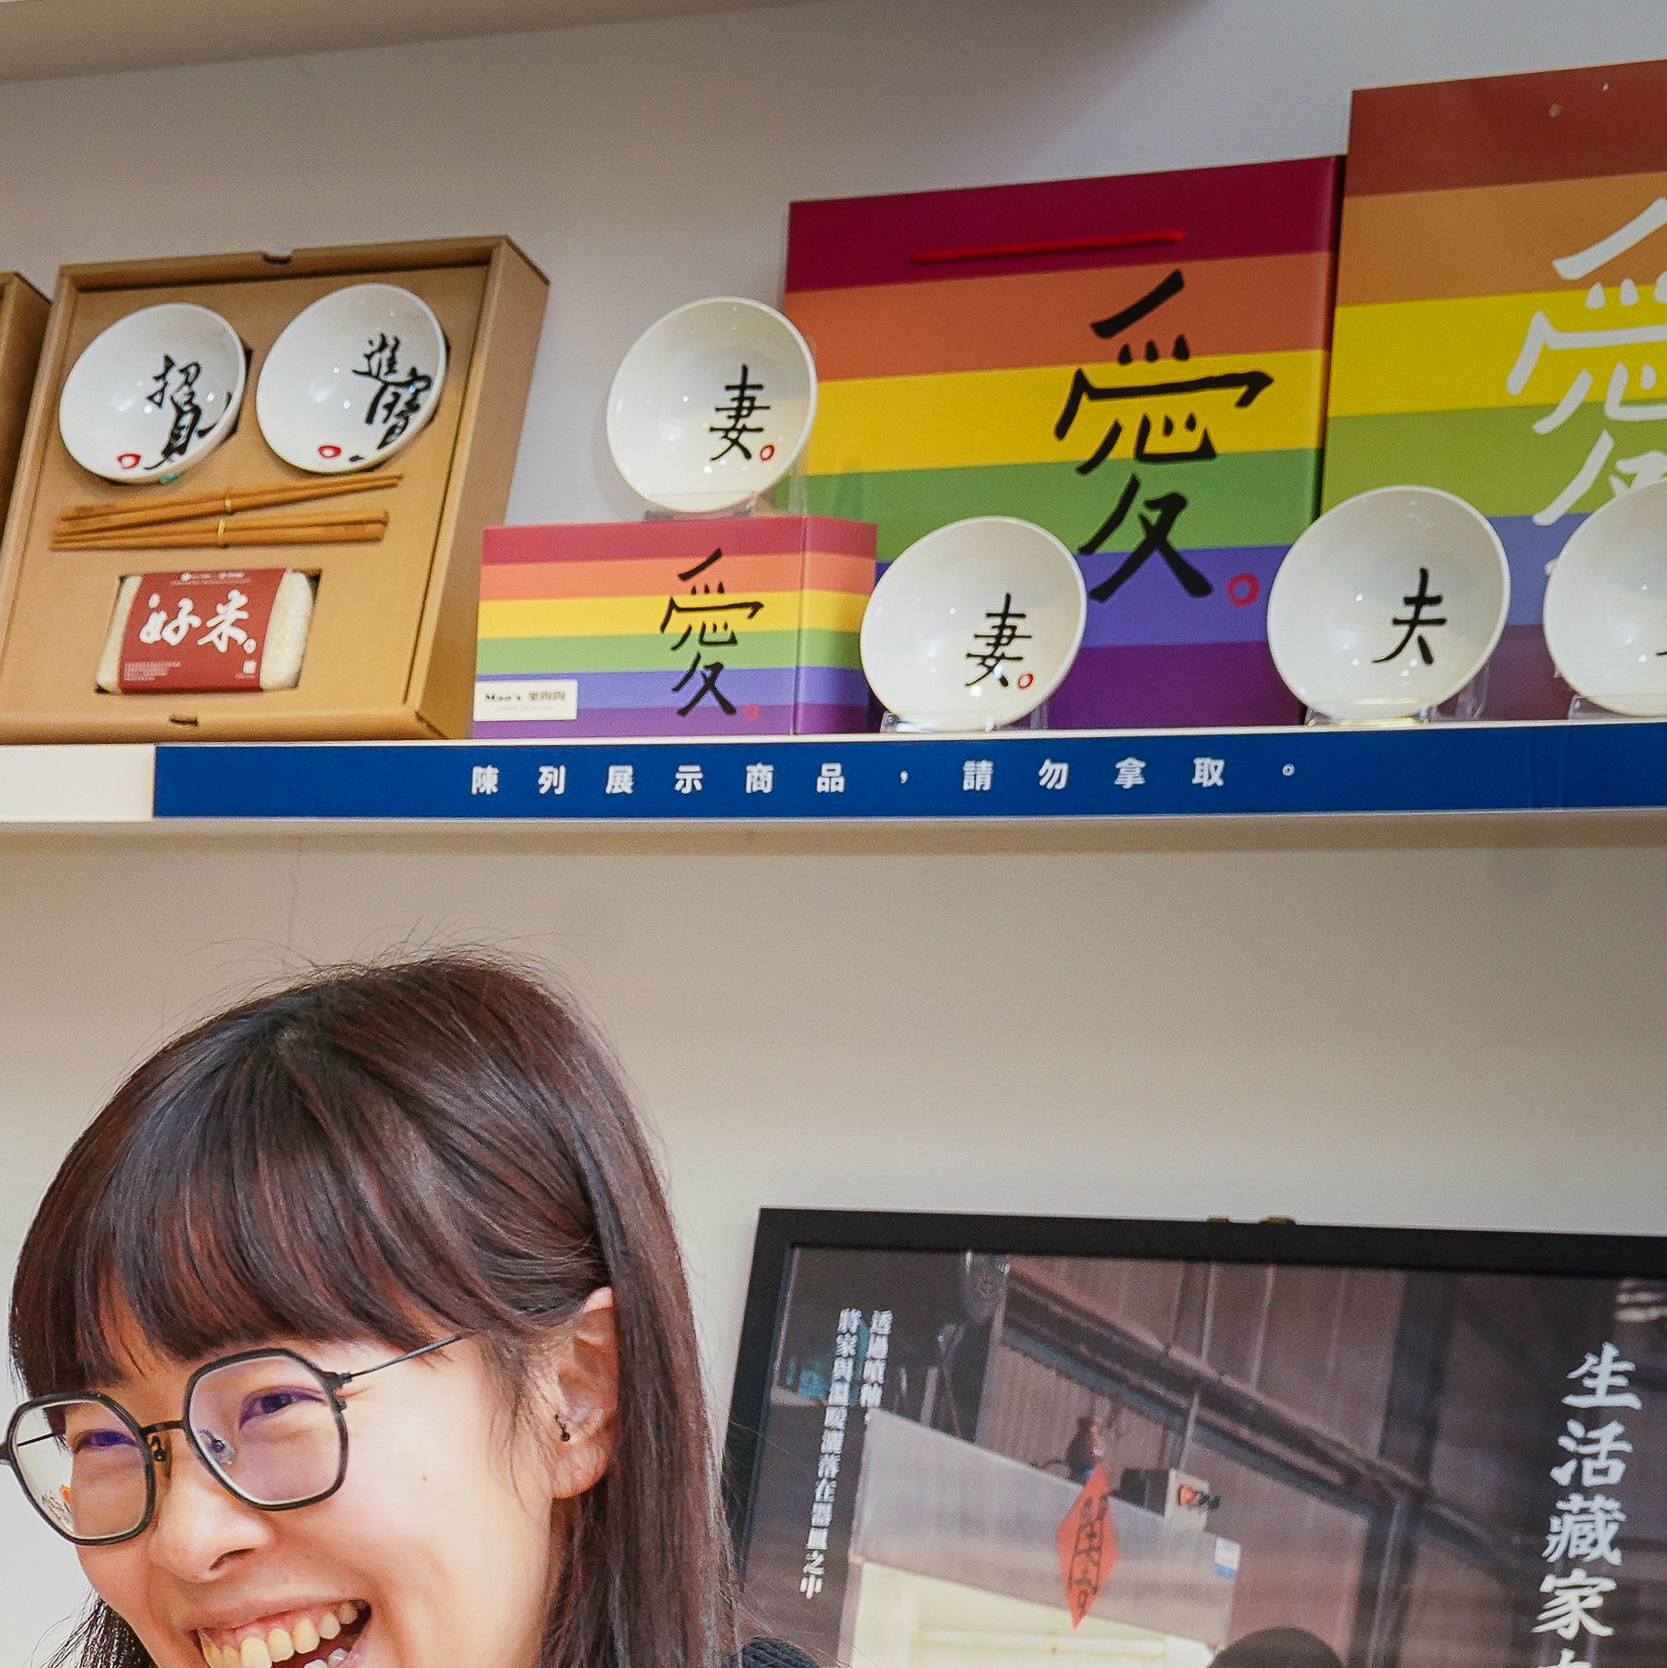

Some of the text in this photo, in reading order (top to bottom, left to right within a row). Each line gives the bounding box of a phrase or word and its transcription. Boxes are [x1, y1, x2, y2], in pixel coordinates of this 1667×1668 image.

[1372, 566, 1447, 666] 夫
[471, 757, 1295, 795] 陳列展示商品，請勿拿取。
